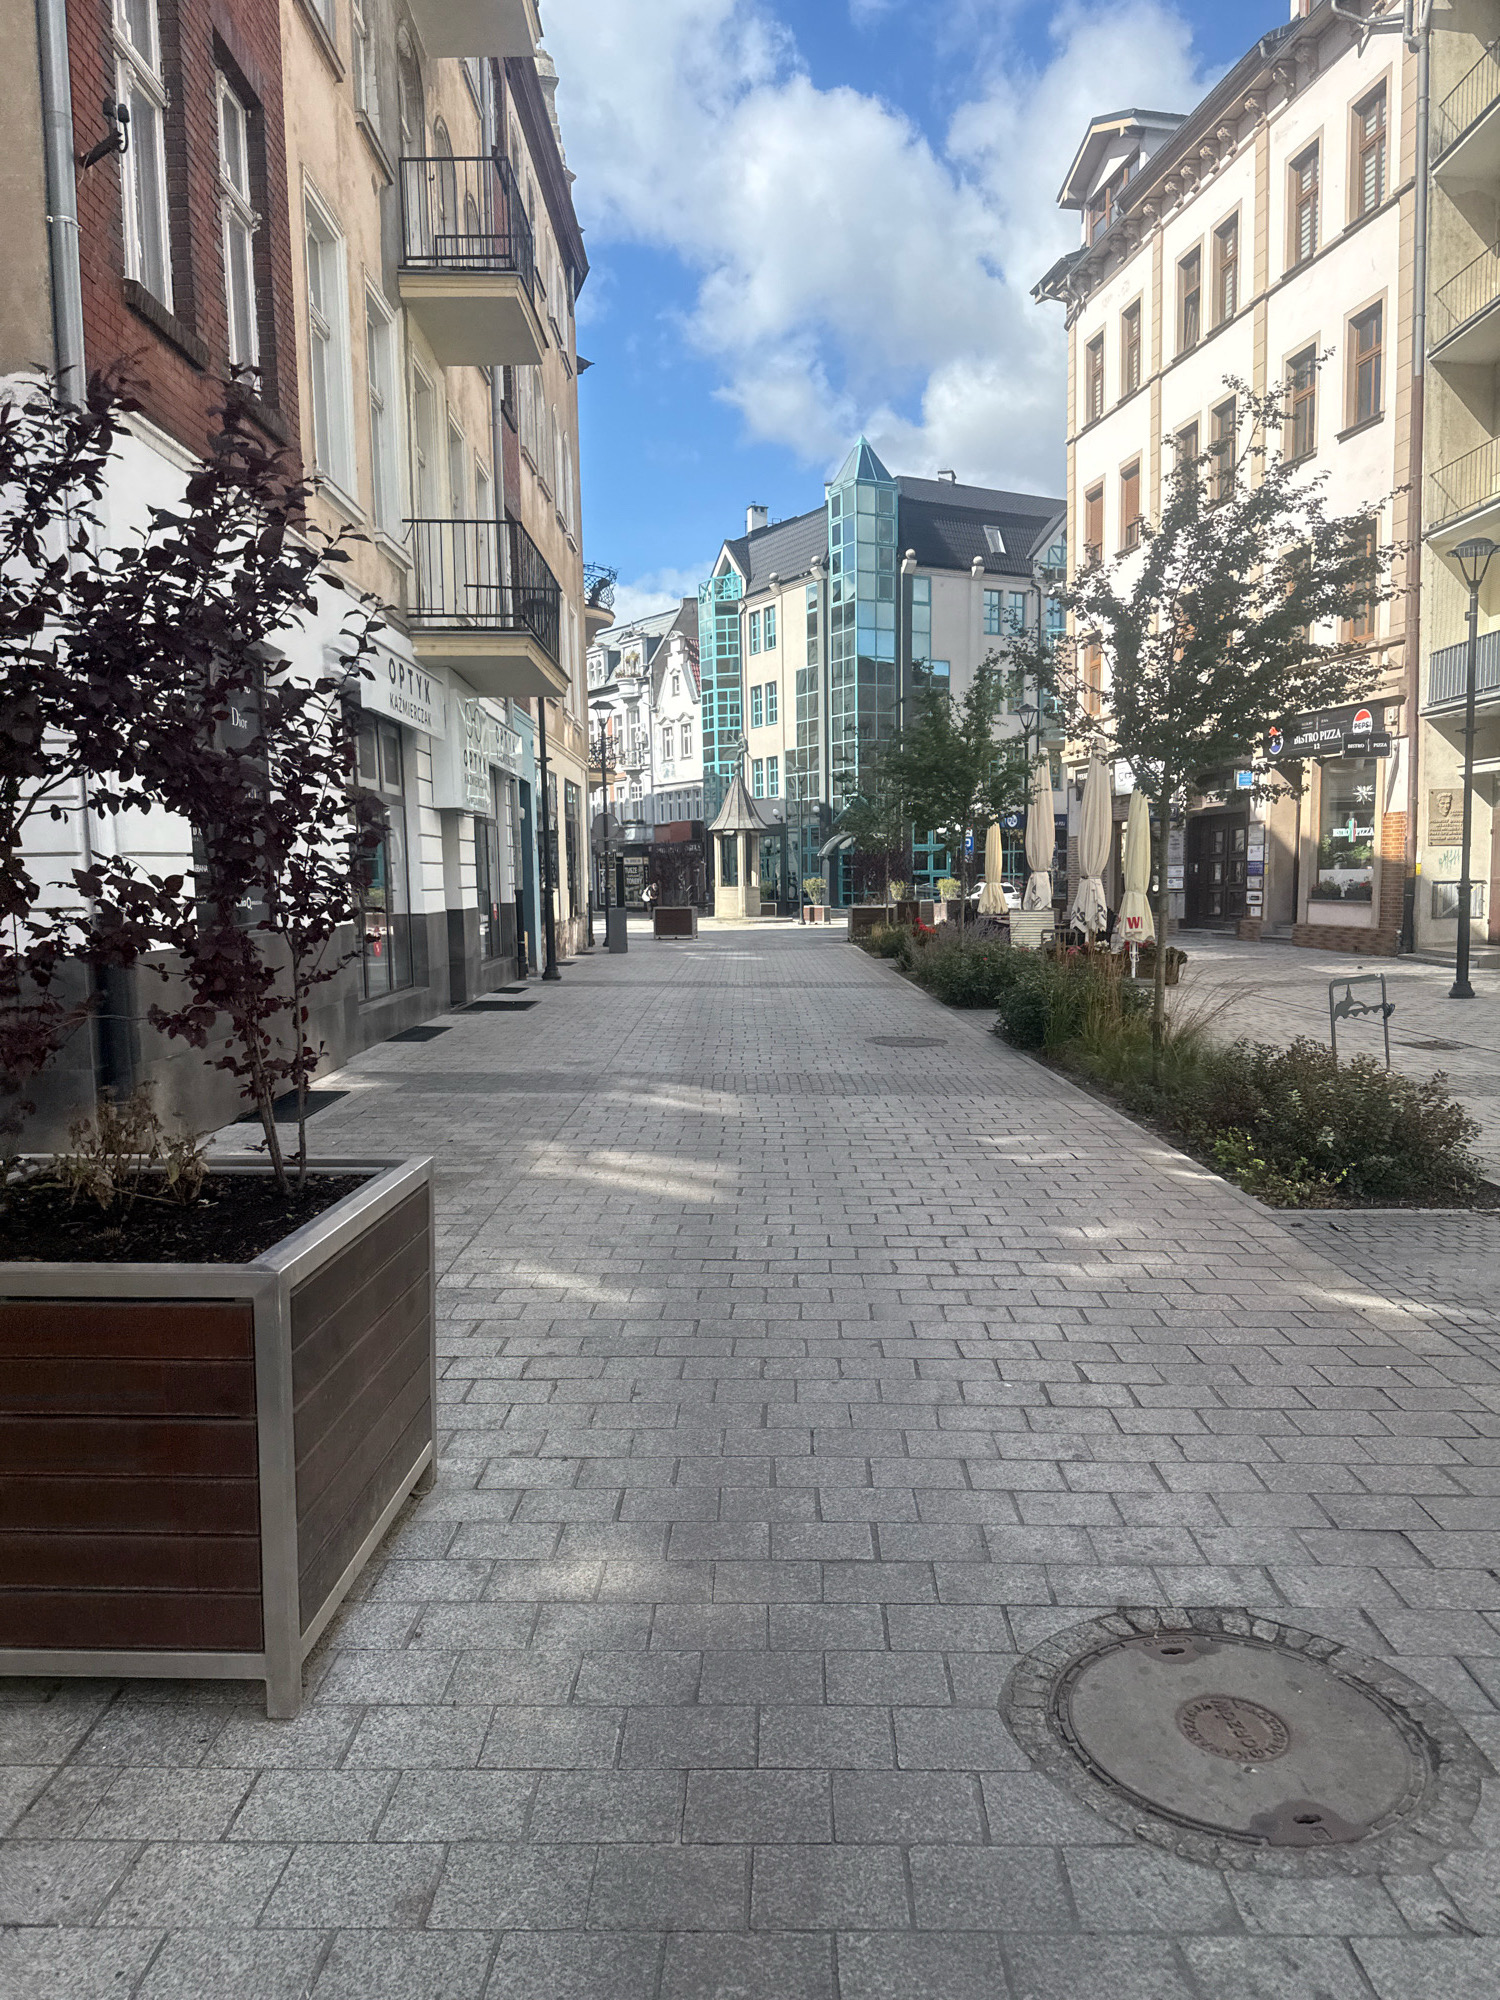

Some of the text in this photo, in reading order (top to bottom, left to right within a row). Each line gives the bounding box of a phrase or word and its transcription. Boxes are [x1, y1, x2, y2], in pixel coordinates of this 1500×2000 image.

[388, 657, 431, 705] OPTYK
[231, 706, 248, 729] Dior
[1353, 721, 1371, 729] PEPSI
[1294, 728, 1341, 744] BISTRO PIZZA
